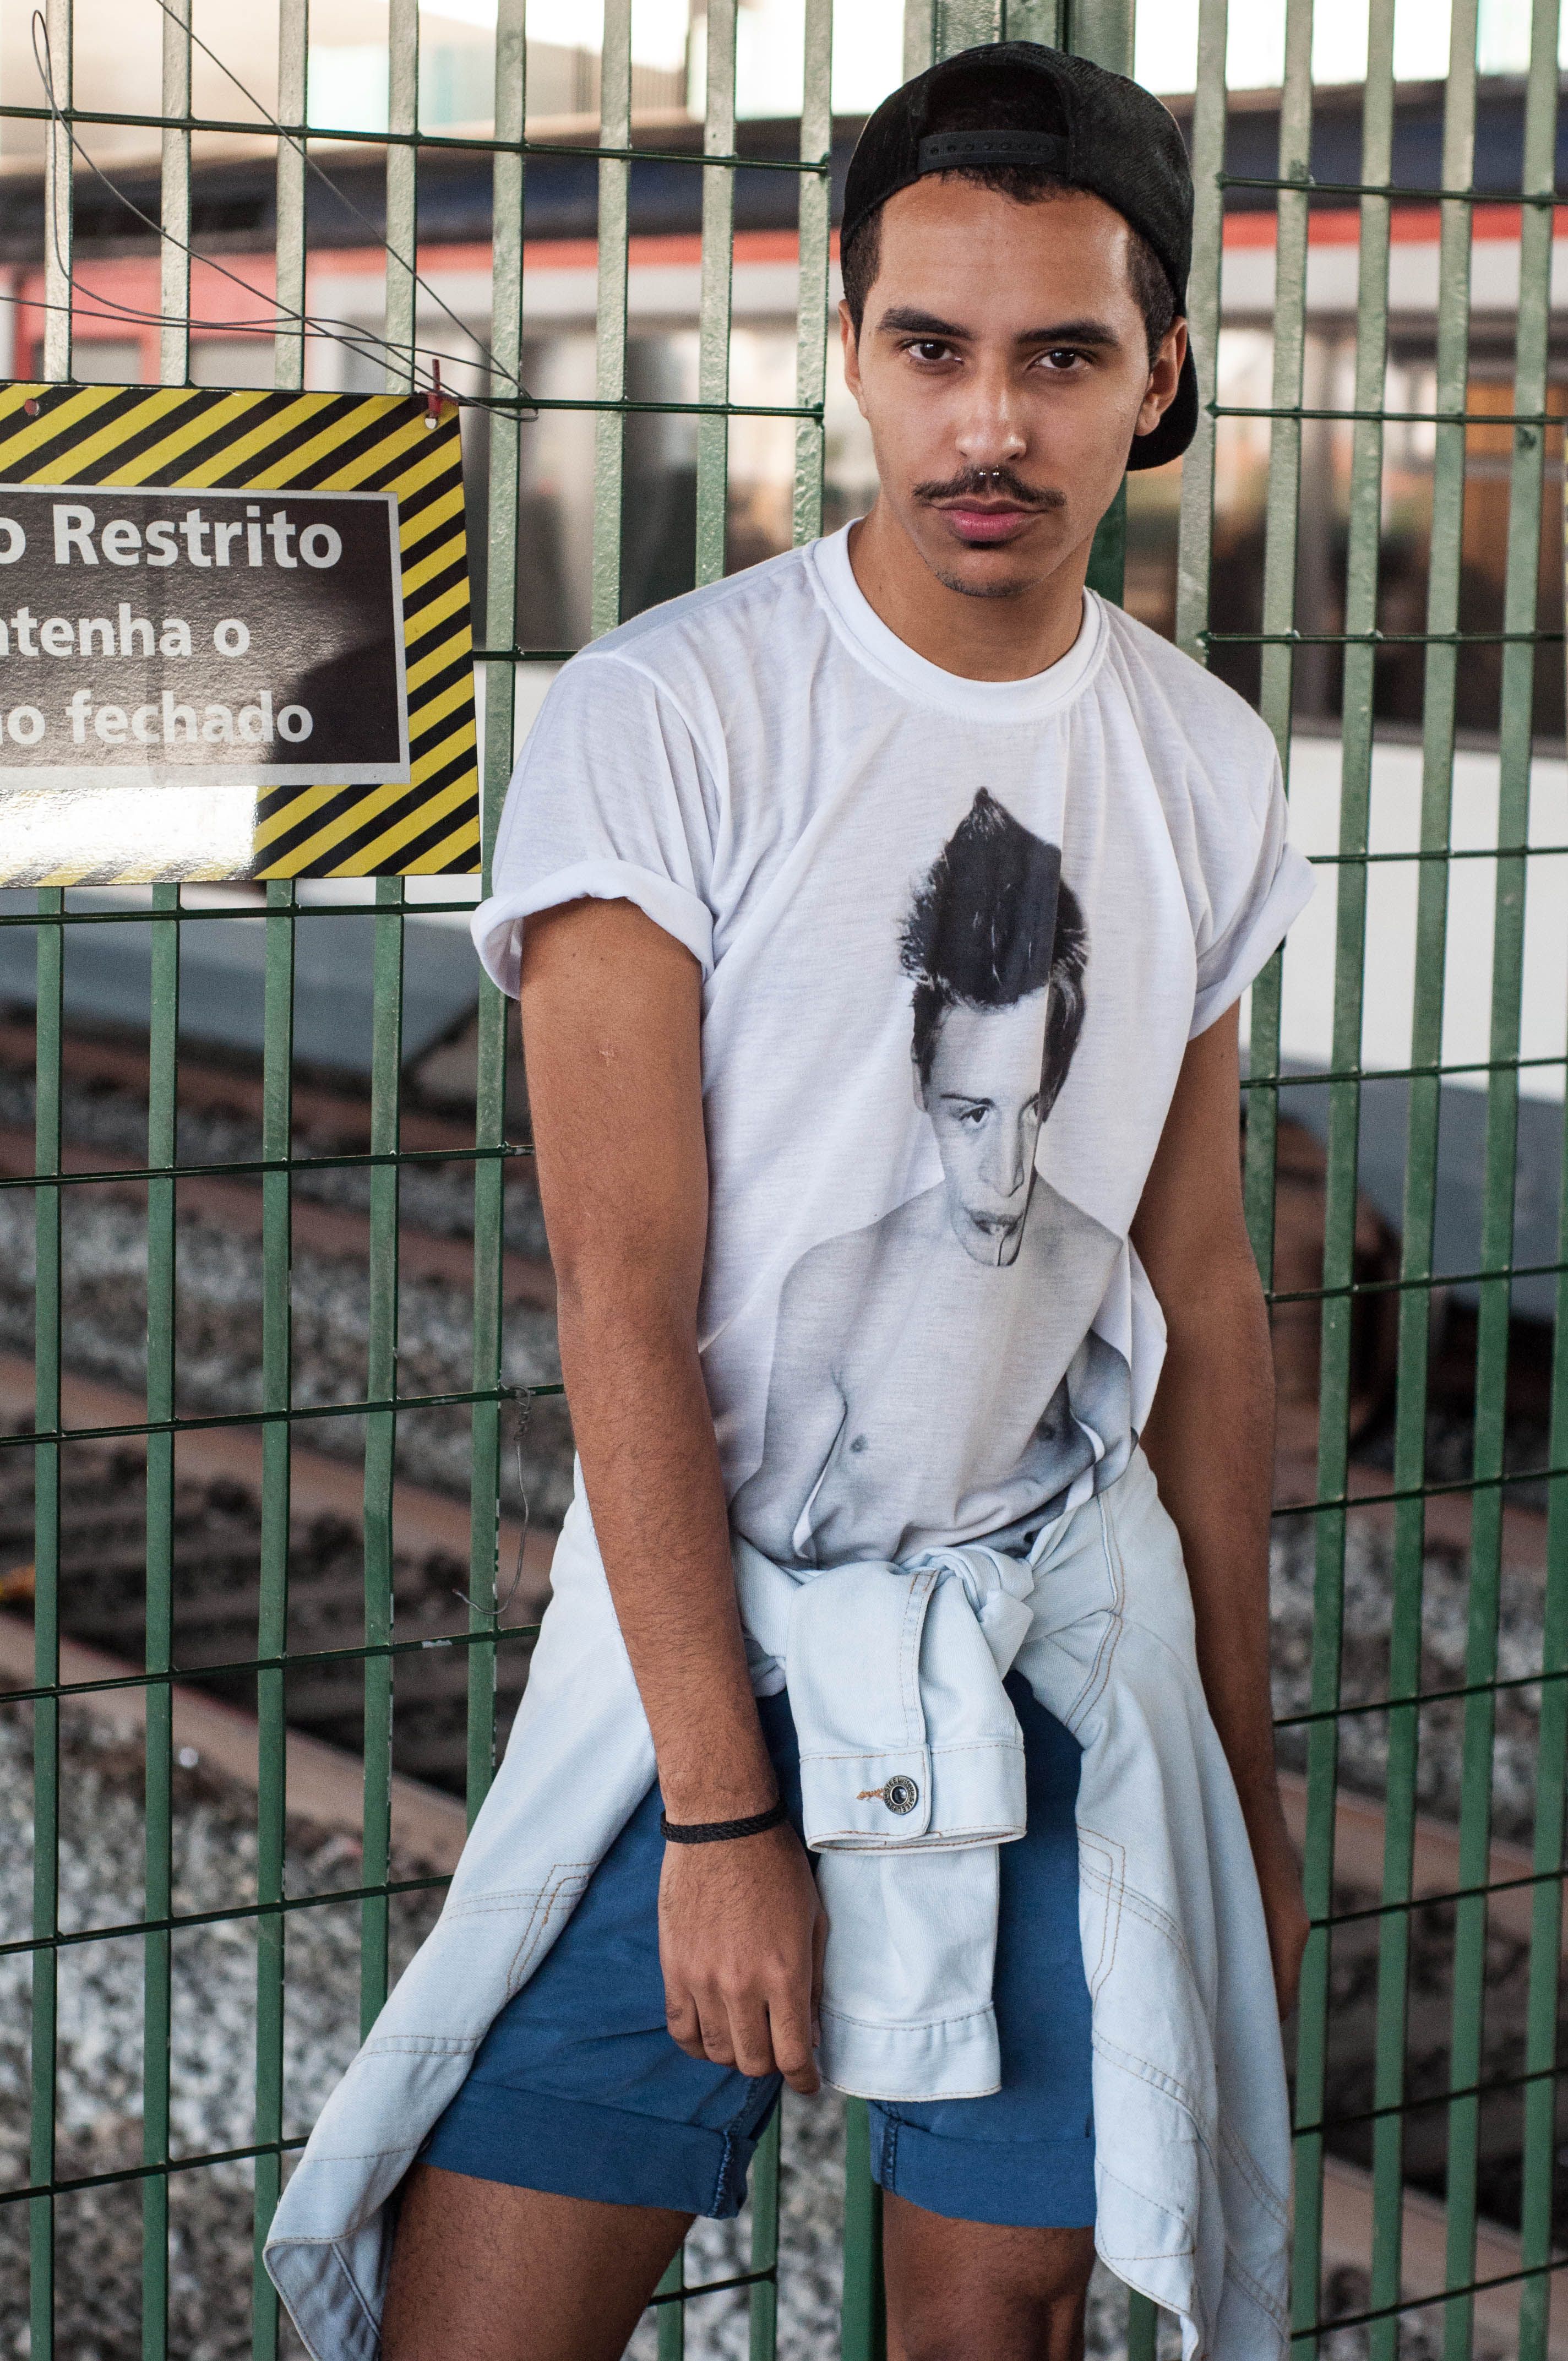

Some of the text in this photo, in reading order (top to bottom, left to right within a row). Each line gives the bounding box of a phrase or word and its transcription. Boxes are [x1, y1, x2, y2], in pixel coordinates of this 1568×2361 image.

[53, 504, 342, 568] Restrito
[0, 603, 250, 657] tenha o
[0, 690, 313, 744] o fechado
